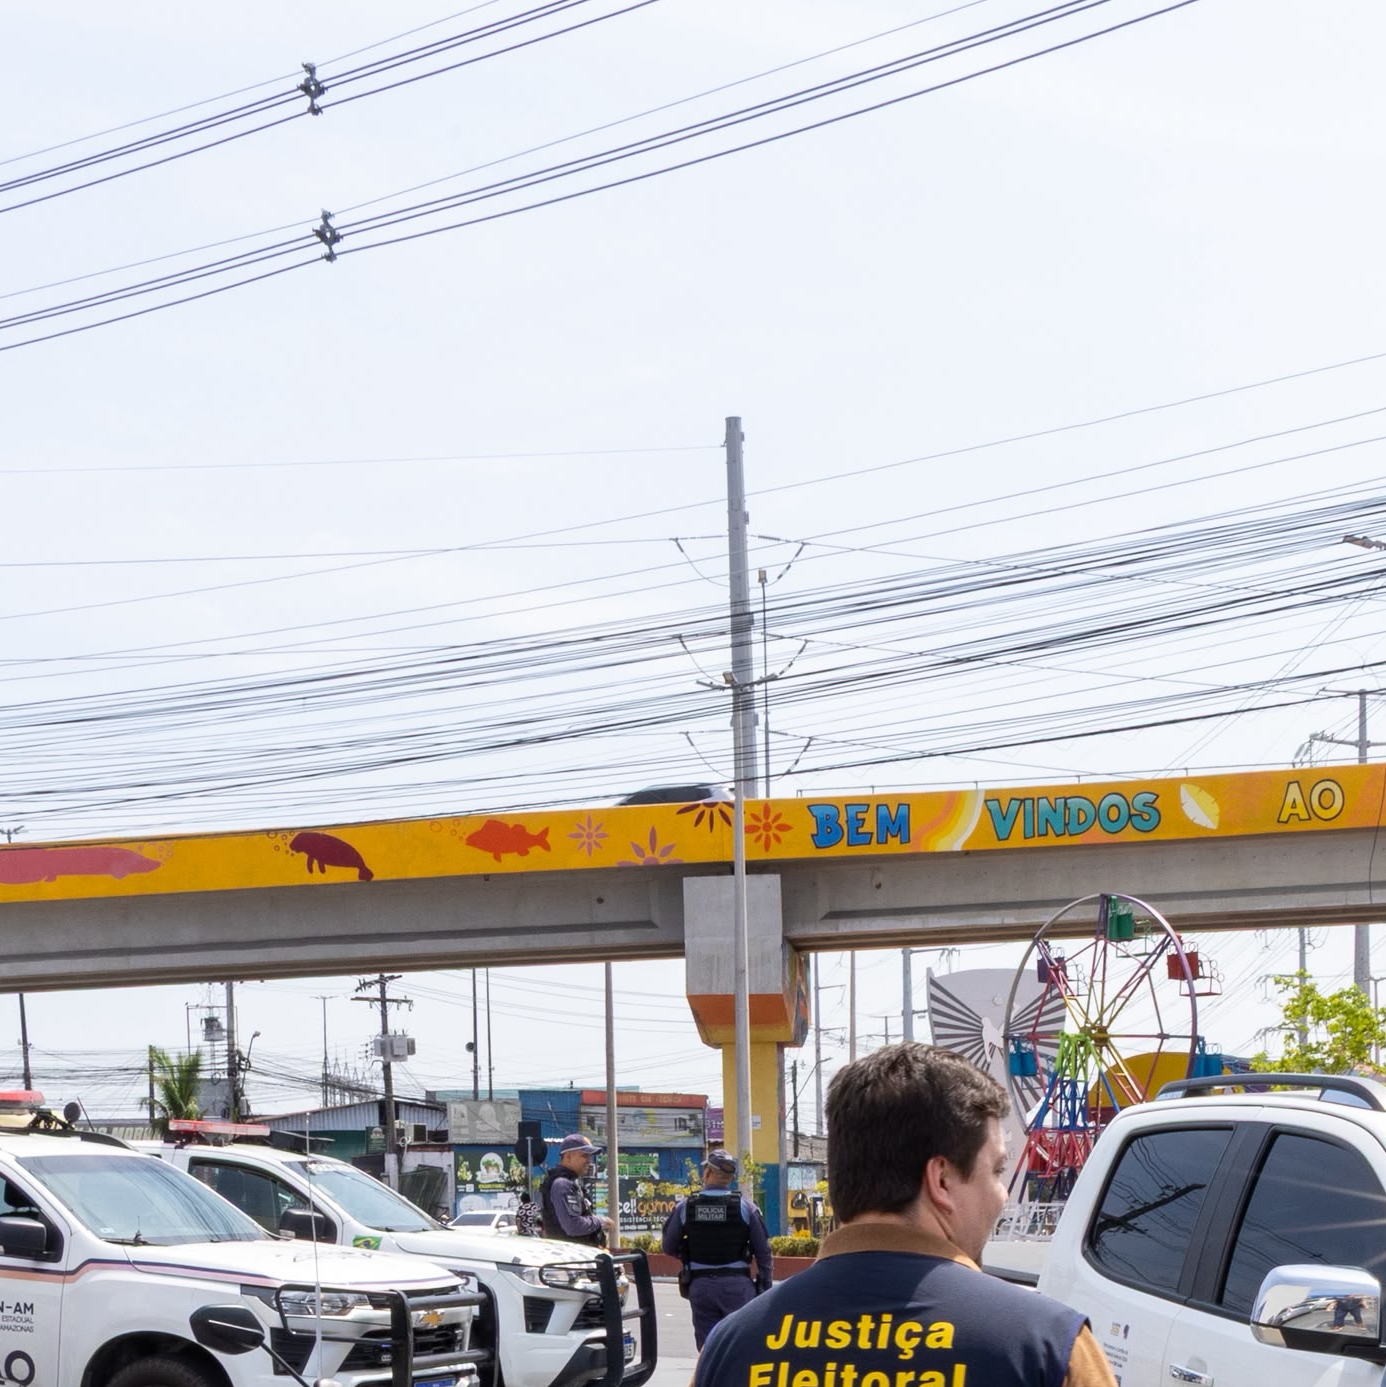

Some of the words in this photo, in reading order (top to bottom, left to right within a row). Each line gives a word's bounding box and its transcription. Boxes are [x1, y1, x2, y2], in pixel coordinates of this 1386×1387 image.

[808, 803, 911, 849] BEM
[985, 791, 1162, 841] VINDOS
[1277, 778, 1345, 824] AO
[0, 1324, 34, 1333] AMAZONAS
[1, 1314, 34, 1324] ESTADUAL
[766, 1313, 955, 1360] Justiça
